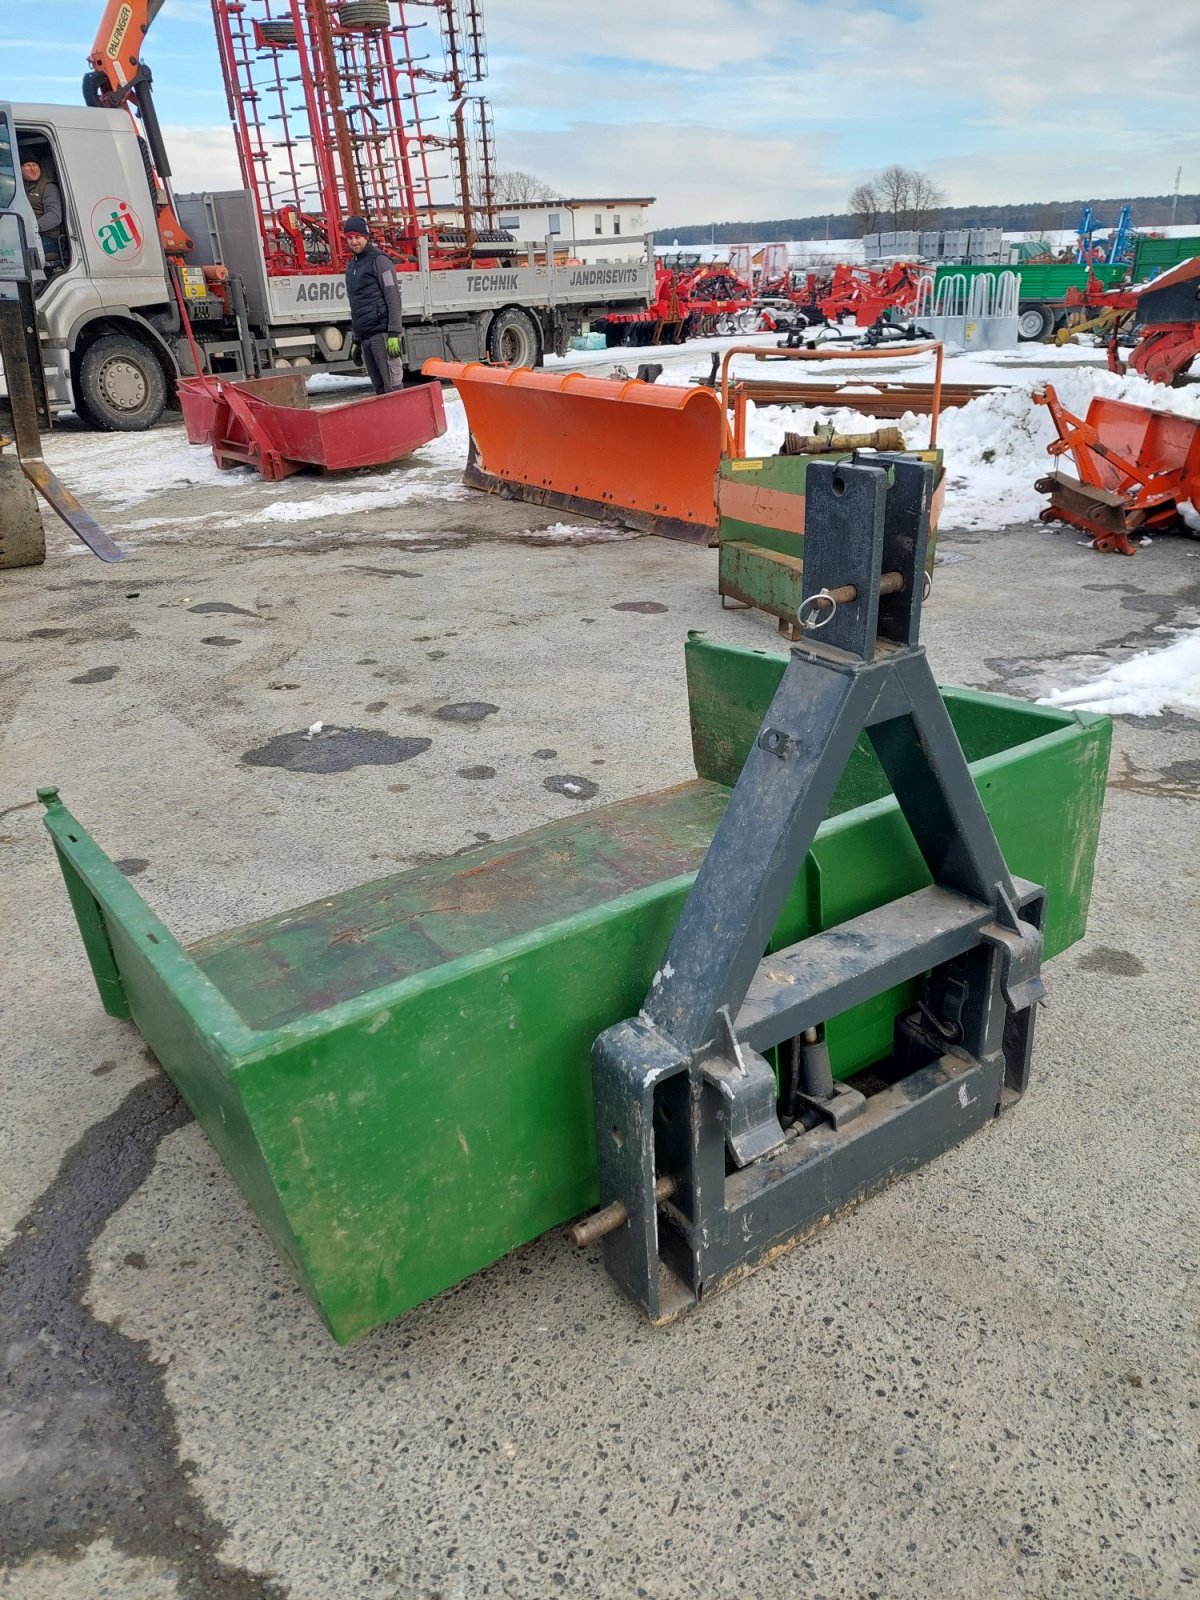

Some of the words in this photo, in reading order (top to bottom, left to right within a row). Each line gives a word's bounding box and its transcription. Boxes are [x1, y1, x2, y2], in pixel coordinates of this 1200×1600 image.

[108, 6, 131, 57] PALFINGER
[466, 274, 519, 293] TECHNIK
[569, 268, 638, 287] JANDRISEVITS
